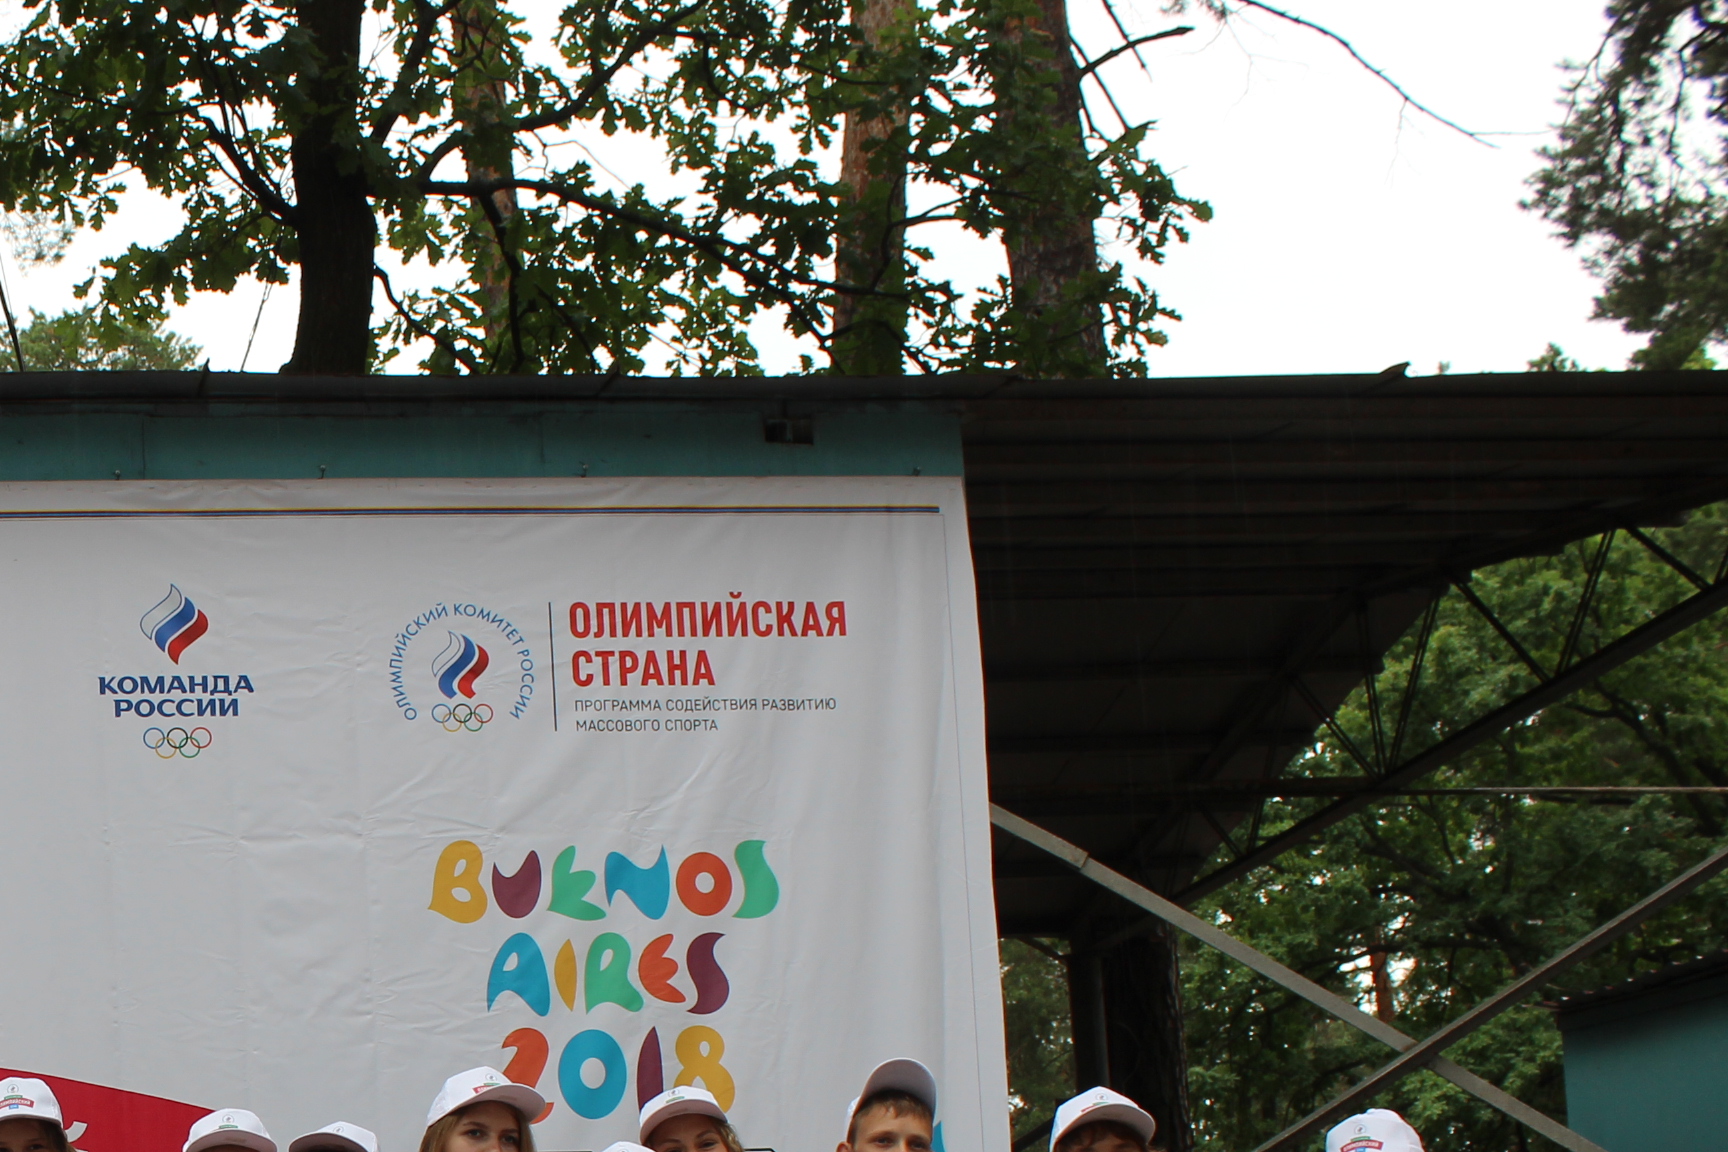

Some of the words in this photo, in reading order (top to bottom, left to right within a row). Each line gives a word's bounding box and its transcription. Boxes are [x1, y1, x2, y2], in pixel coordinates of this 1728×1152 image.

[569, 591, 848, 639] ОЛИМПИЙСКАЯ
[389, 602, 449, 720] ОЛИМПИЙСКИЙ
[453, 603, 525, 646] КОМИТЕТ
[509, 649, 535, 720] РОССИИ
[572, 650, 716, 687] СТРАНА
[98, 674, 255, 696] КОМАНДА
[574, 699, 662, 712] ПРОГРАММА
[665, 696, 758, 713] СОДЕЙСТВИЯ
[761, 697, 837, 711] РАЗВИТИЮ
[113, 698, 239, 718] РОССИИ
[576, 719, 661, 732] МАССОВОГО
[664, 719, 719, 731] СПОРТА
[427, 840, 780, 924] BUENOS
[486, 932, 730, 1017] AIRES
[501, 1025, 736, 1125] 2018
